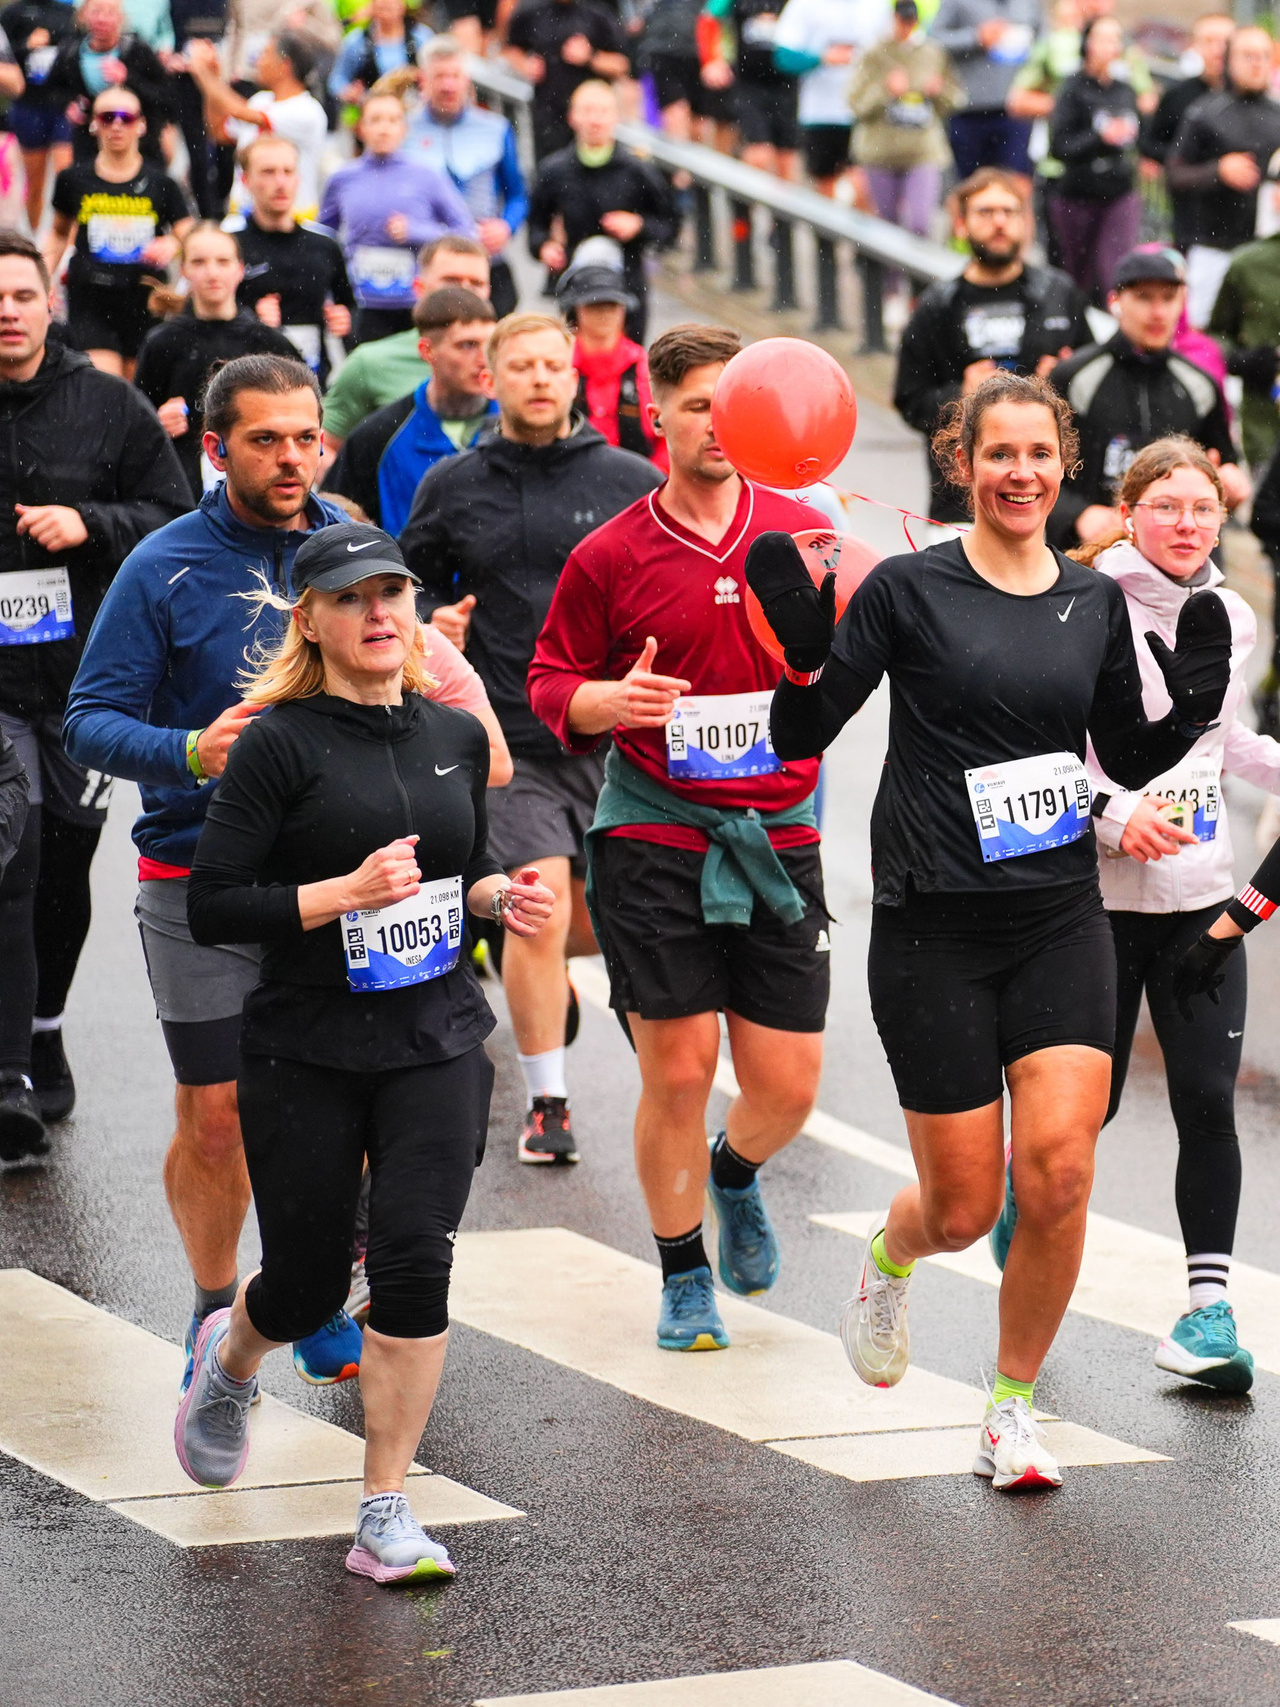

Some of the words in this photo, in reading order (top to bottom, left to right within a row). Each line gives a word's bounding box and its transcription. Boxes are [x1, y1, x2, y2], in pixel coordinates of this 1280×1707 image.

[696, 722, 759, 751] 10107
[1003, 785, 1069, 824] 11791
[451, 889, 459, 899] KM
[377, 914, 443, 956] 10053
[405, 954, 423, 966] INESA
